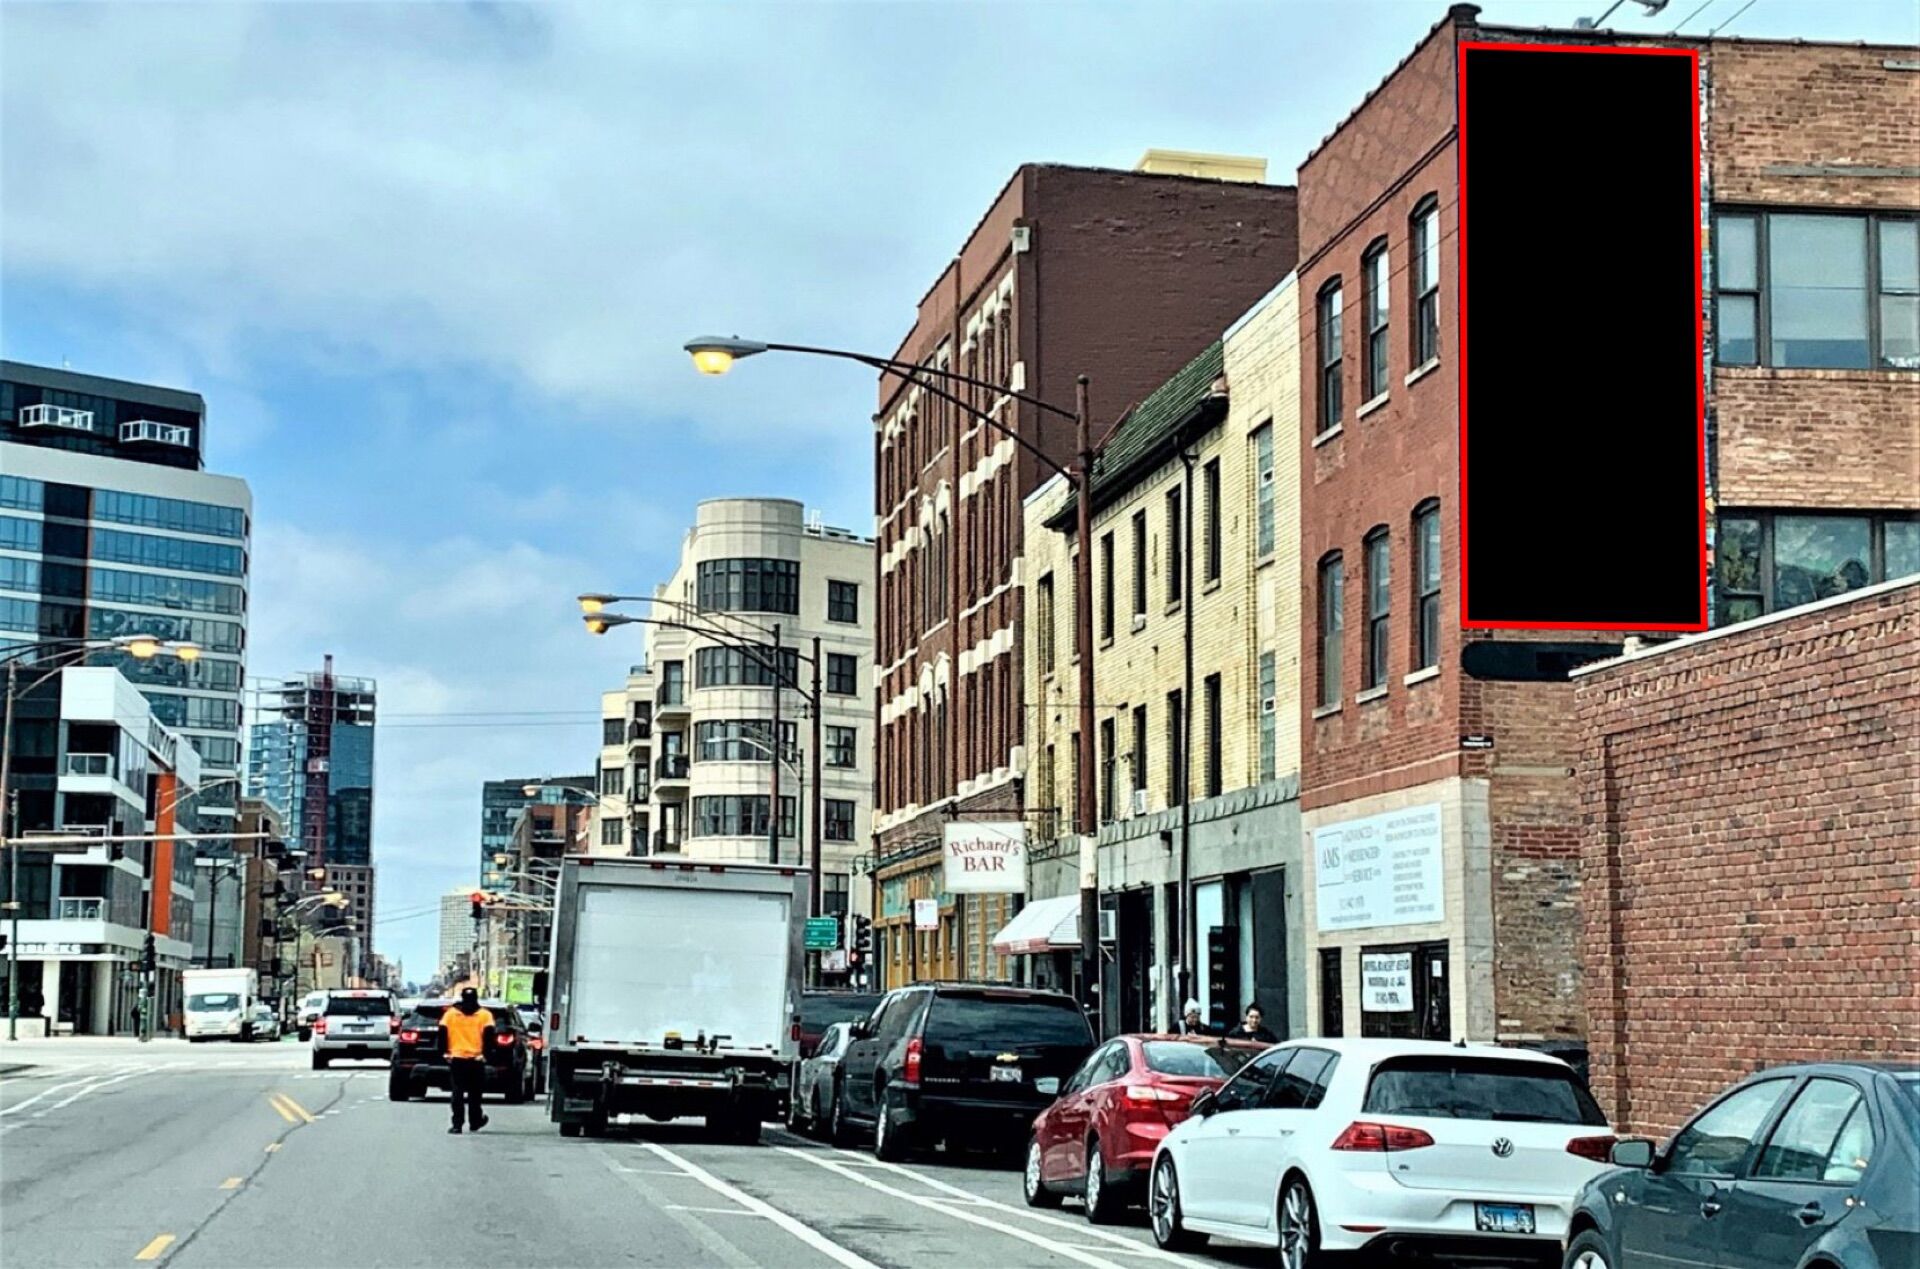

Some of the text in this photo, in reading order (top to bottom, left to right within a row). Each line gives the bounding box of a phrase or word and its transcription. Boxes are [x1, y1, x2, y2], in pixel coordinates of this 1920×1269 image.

[950, 836, 1021, 857] Richard's
[963, 856, 1005, 872] BAR
[1321, 846, 1340, 869] AMS
